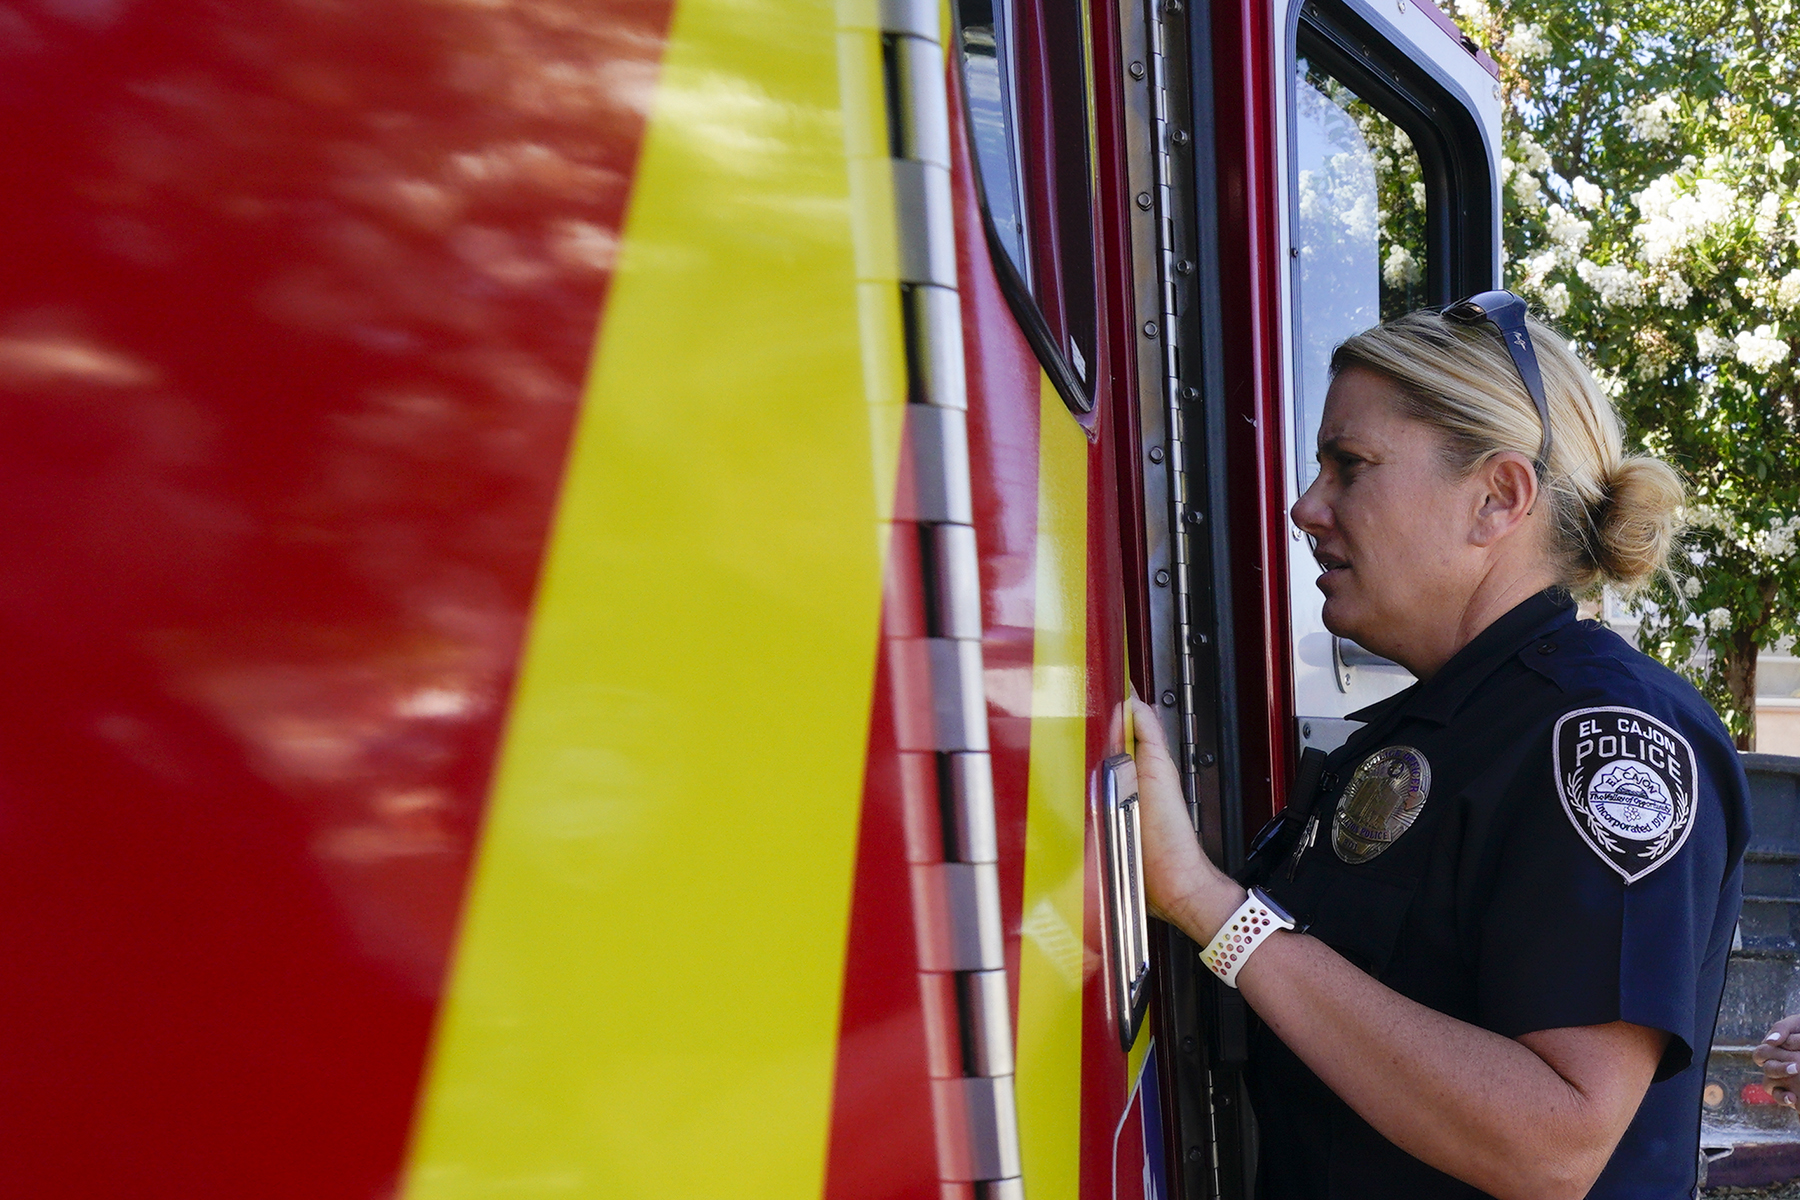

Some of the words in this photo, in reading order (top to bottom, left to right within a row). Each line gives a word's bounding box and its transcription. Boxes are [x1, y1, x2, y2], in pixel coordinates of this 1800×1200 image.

[1579, 719, 1602, 738] EL
[1617, 719, 1676, 756] CAJON
[1576, 735, 1683, 784] POLICE
[1605, 775, 1622, 788] EL
[1623, 772, 1658, 794] CAJON
[1604, 793, 1626, 804] Valley
[1626, 796, 1633, 805] of
[1595, 803, 1653, 833] Incorporated
[1359, 827, 1388, 840] POLICE
